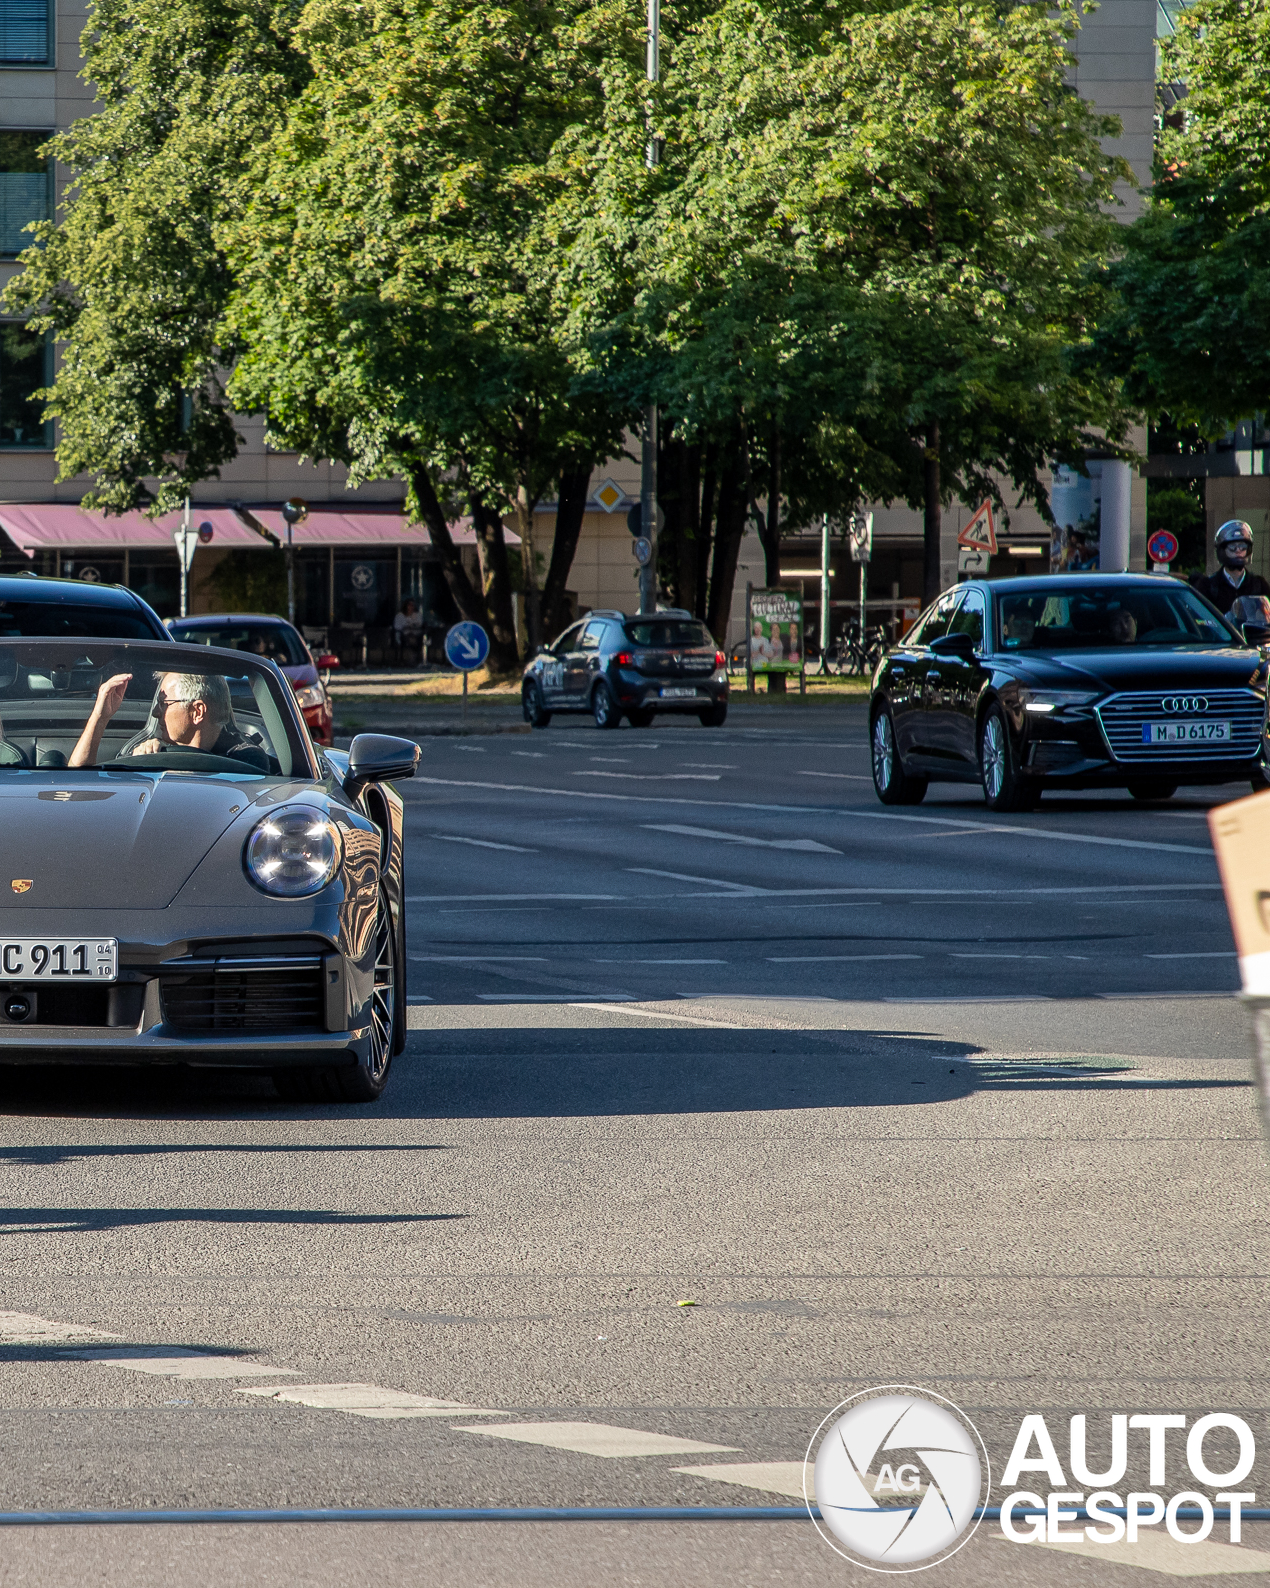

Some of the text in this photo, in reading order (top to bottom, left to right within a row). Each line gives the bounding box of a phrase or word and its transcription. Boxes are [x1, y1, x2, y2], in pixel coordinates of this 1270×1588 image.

[1156, 724, 1225, 740] M D 6175
[96, 944, 112, 954] 04
[30, 944, 92, 975] 911
[96, 965, 112, 975] 10
